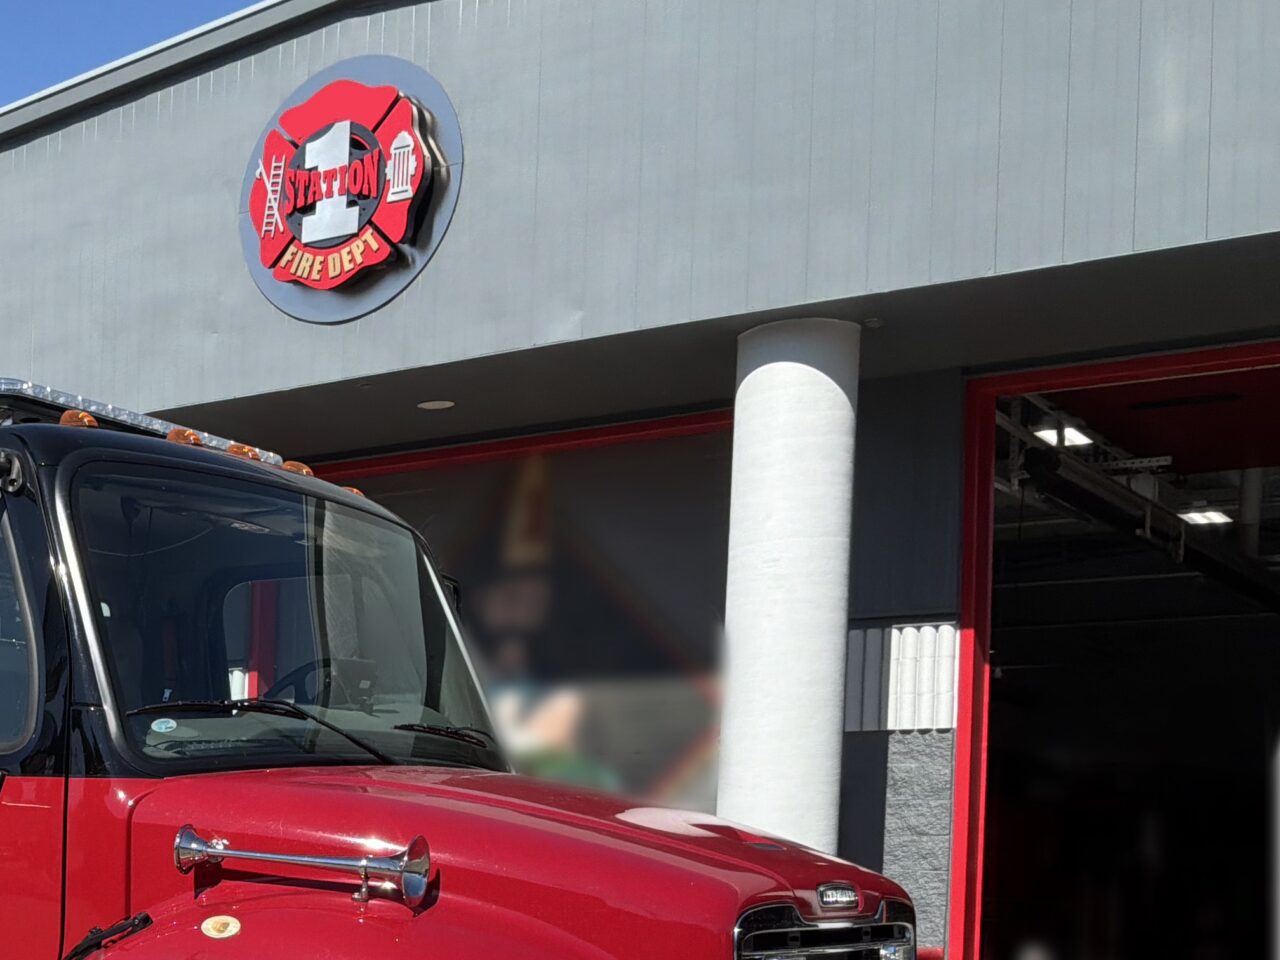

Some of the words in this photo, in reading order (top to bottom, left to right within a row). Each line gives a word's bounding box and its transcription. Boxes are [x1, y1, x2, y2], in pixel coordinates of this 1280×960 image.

[284, 147, 380, 215] STATION
[301, 119, 360, 244] 1
[279, 244, 324, 281] FIRE
[328, 232, 380, 280] DEPT
